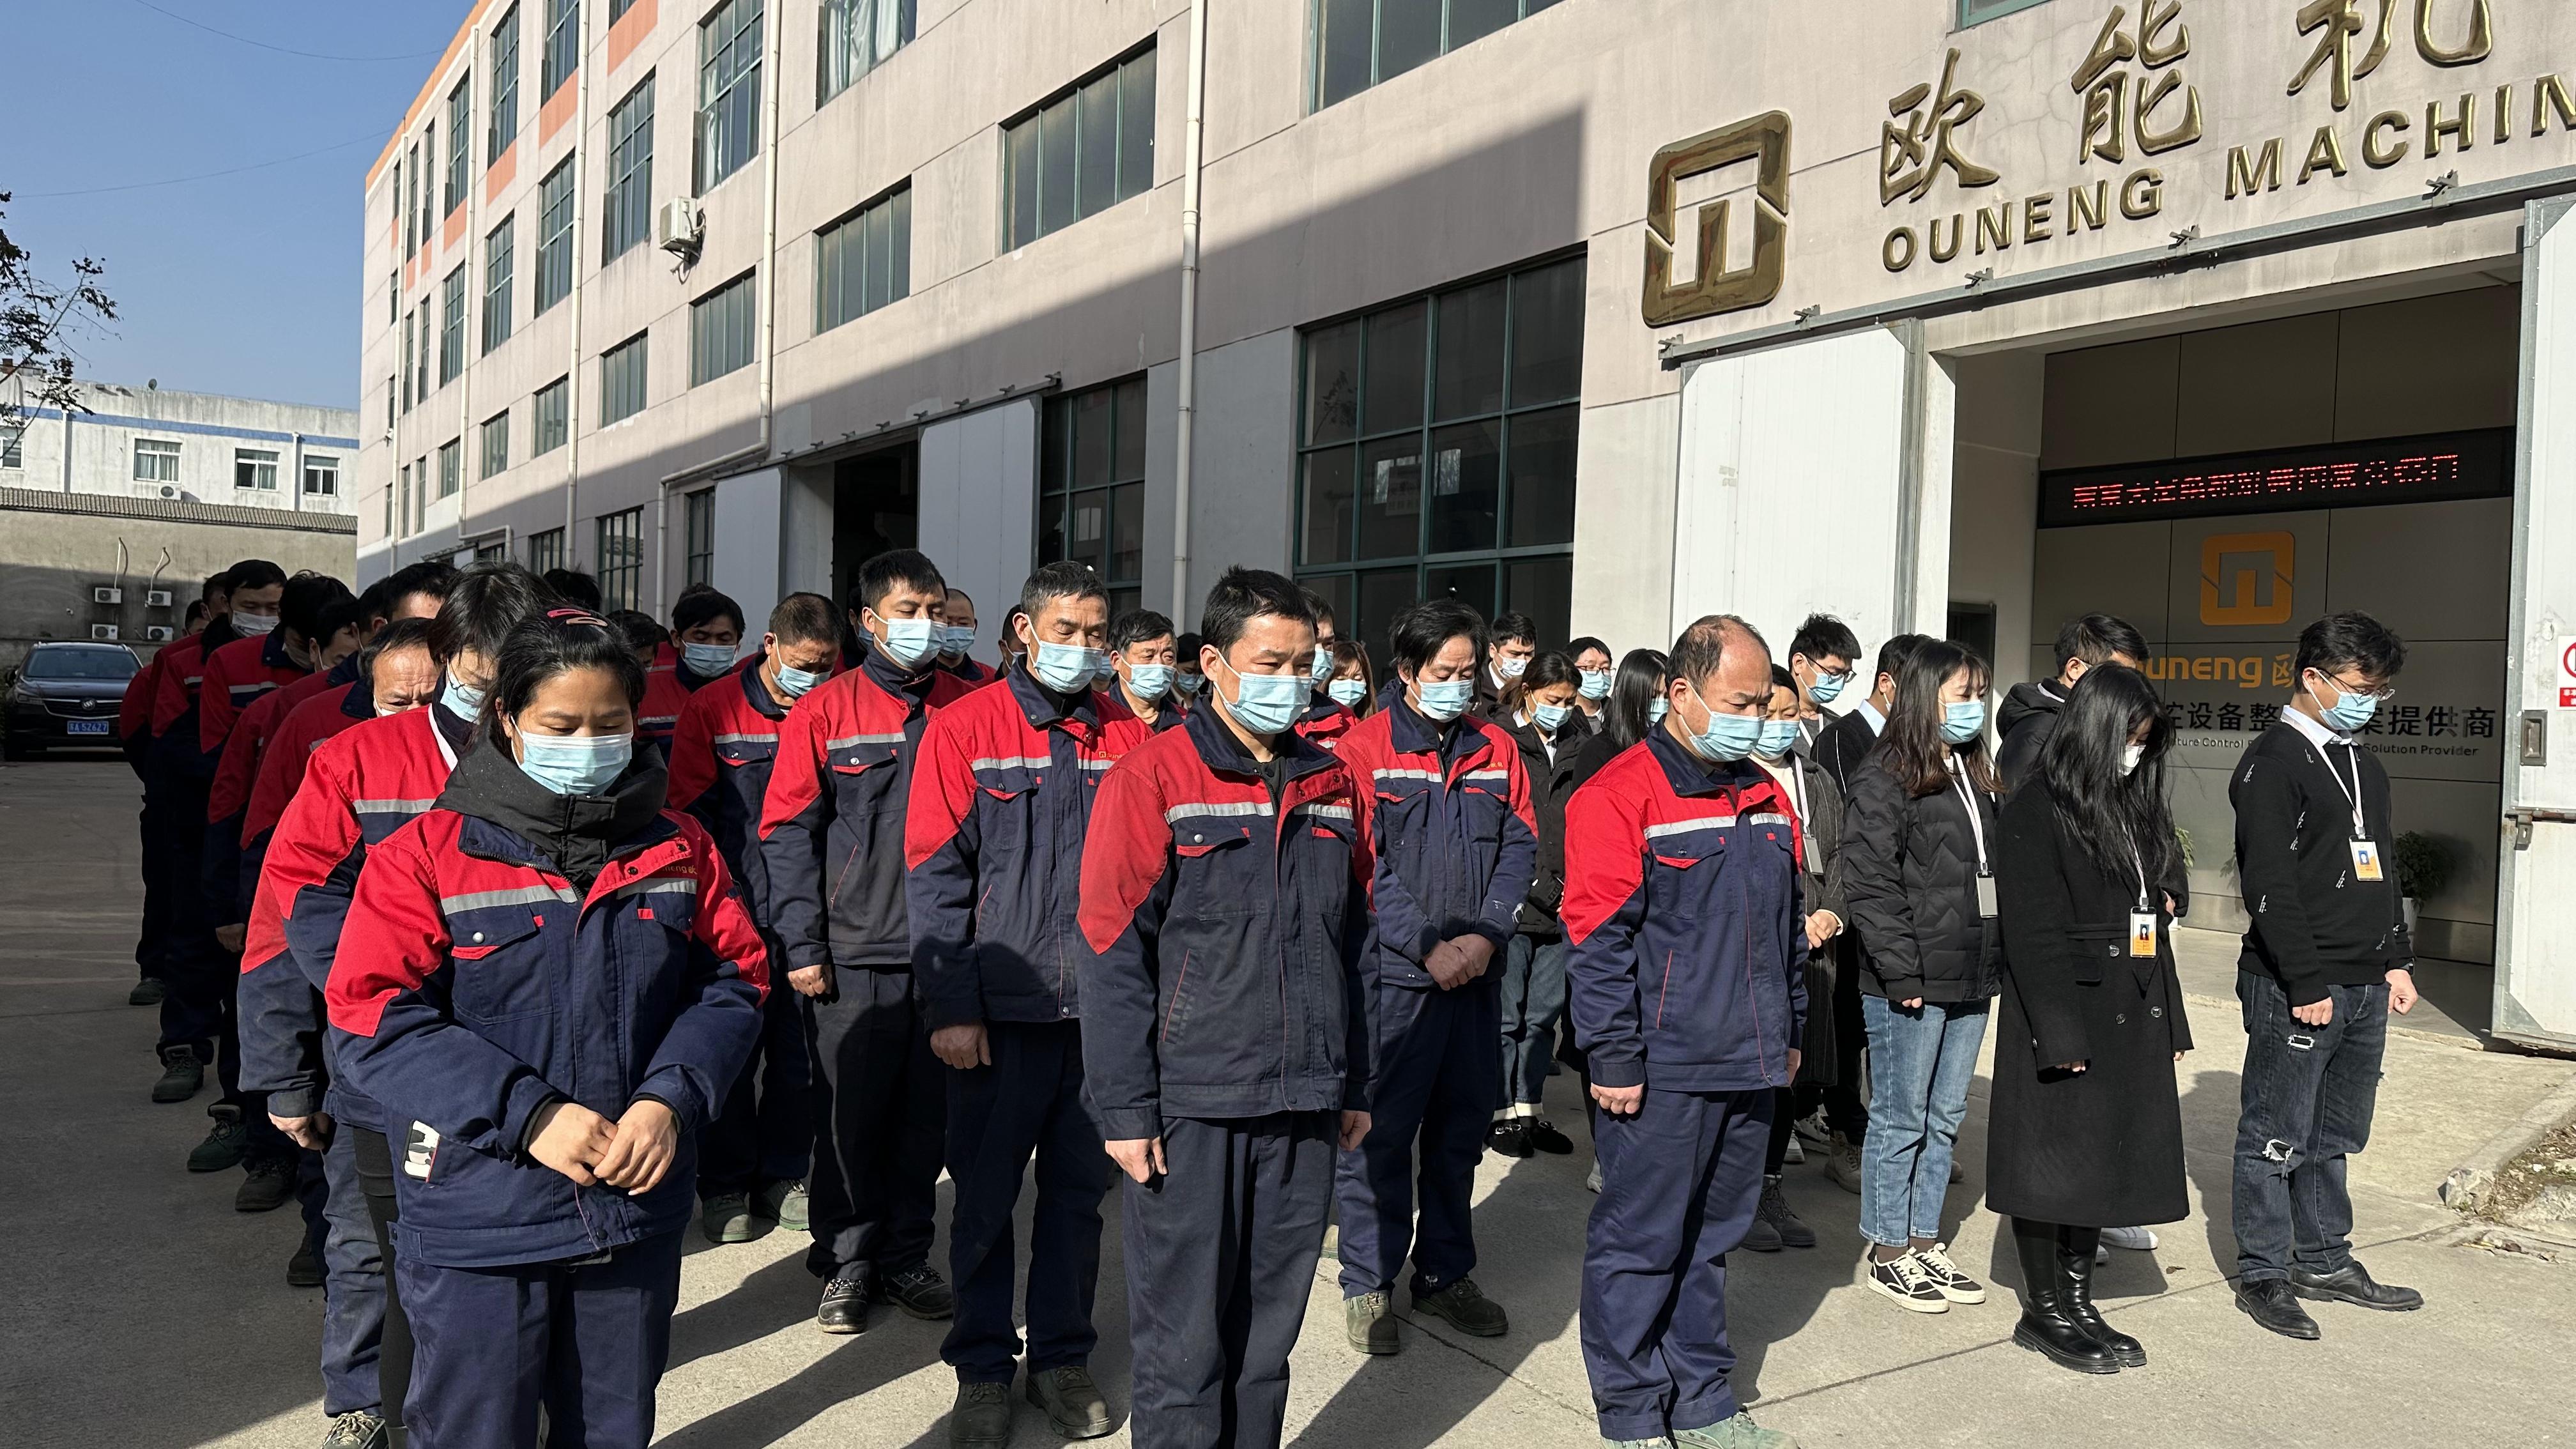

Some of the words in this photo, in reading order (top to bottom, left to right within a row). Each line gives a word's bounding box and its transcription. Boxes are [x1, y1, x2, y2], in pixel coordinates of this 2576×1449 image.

[1881, 167, 2165, 273] OUNENG
[2137, 656, 2262, 689] uneng
[2202, 737, 2244, 748] Control
[2421, 744, 2480, 756] Provider
